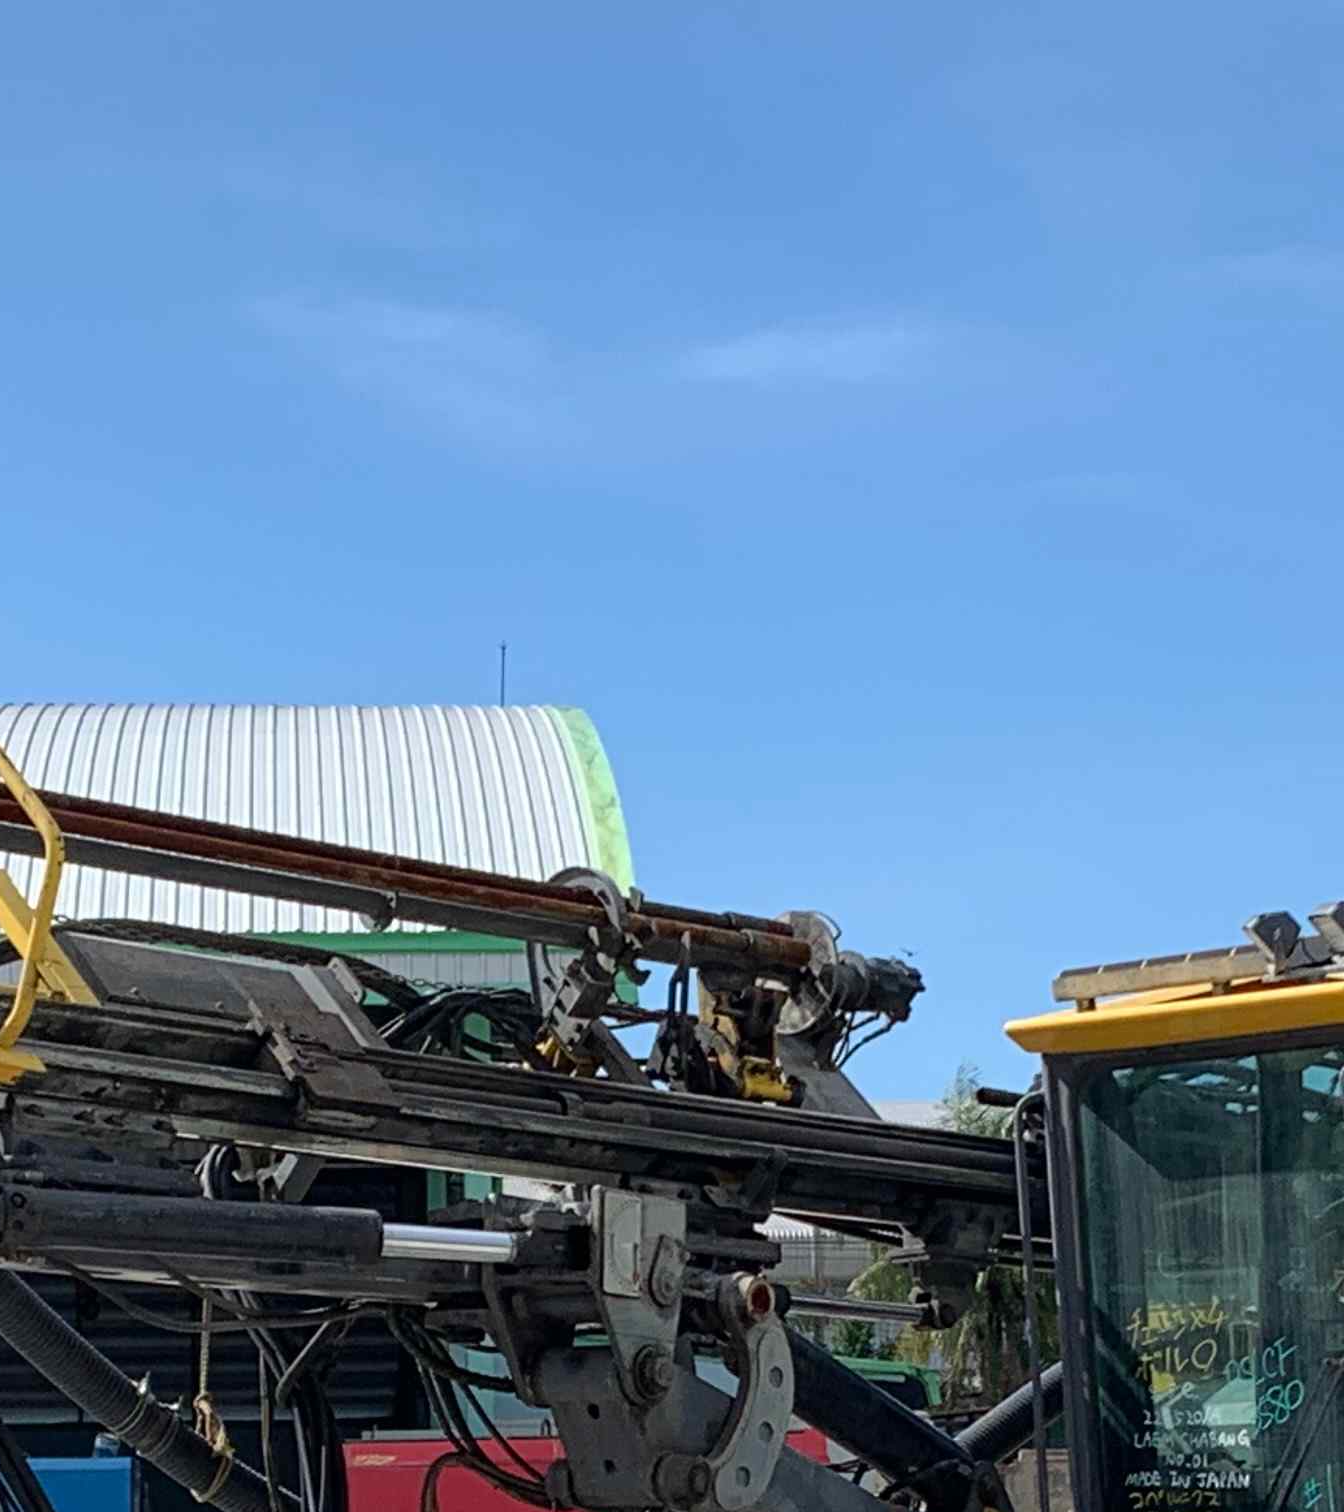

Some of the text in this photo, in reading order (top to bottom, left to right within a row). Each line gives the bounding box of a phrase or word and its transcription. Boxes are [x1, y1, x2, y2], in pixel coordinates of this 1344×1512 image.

[1125, 1470, 1251, 1489] MADE IN JAPAN
